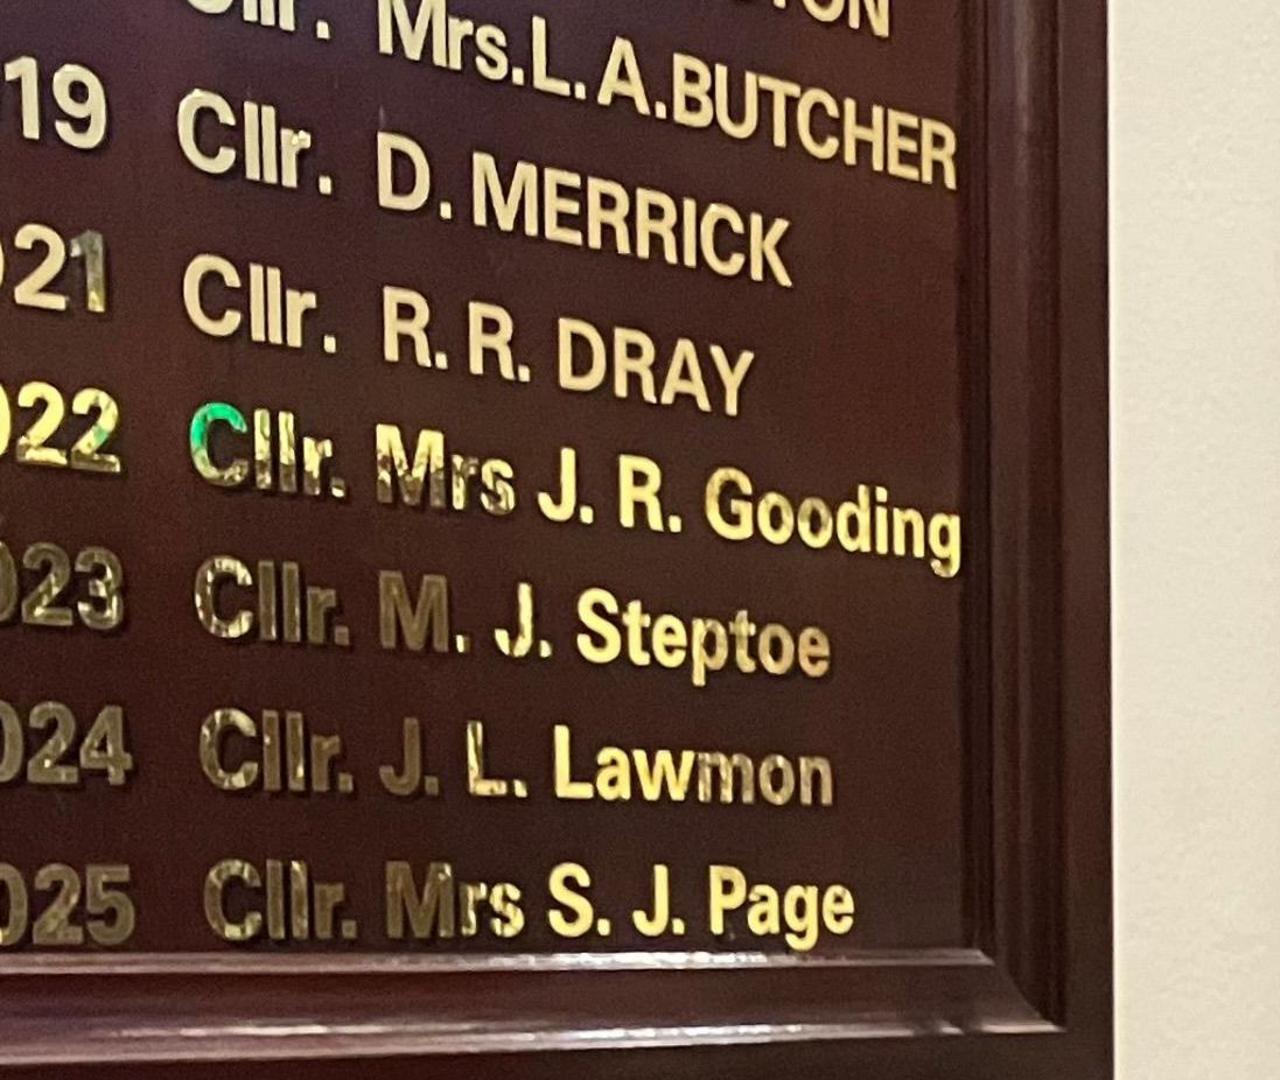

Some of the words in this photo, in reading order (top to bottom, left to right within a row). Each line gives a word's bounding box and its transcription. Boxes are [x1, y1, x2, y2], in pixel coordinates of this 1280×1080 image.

[5, 56, 107, 149] 19
[177, 89, 332, 195] Cllr.
[377, 131, 452, 220] D.
[472, 151, 792, 288] MERRICK
[183, 254, 337, 354] Cllr.
[383, 286, 448, 370] R.
[468, 302, 531, 383] R.
[558, 318, 754, 416] DRAY
[190, 402, 346, 498] Cllr.
[376, 424, 516, 515] Mrs
[538, 448, 594, 525] J.
[619, 455, 682, 533] R.
[705, 467, 961, 578] Gooding
[194, 555, 350, 646] Cllr.
[379, 570, 470, 653] M.
[494, 583, 552, 657] J.
[577, 588, 831, 686] Steptoe
[201, 707, 353, 793] Cllr.
[379, 717, 440, 796] J.
[467, 720, 528, 797] L.
[554, 725, 834, 806] Lawmon
[203, 858, 357, 942] Cllr.
[386, 861, 525, 939] Mrs
[549, 862, 611, 938] S.
[632, 864, 685, 937] J.
[709, 865, 855, 950] Page
